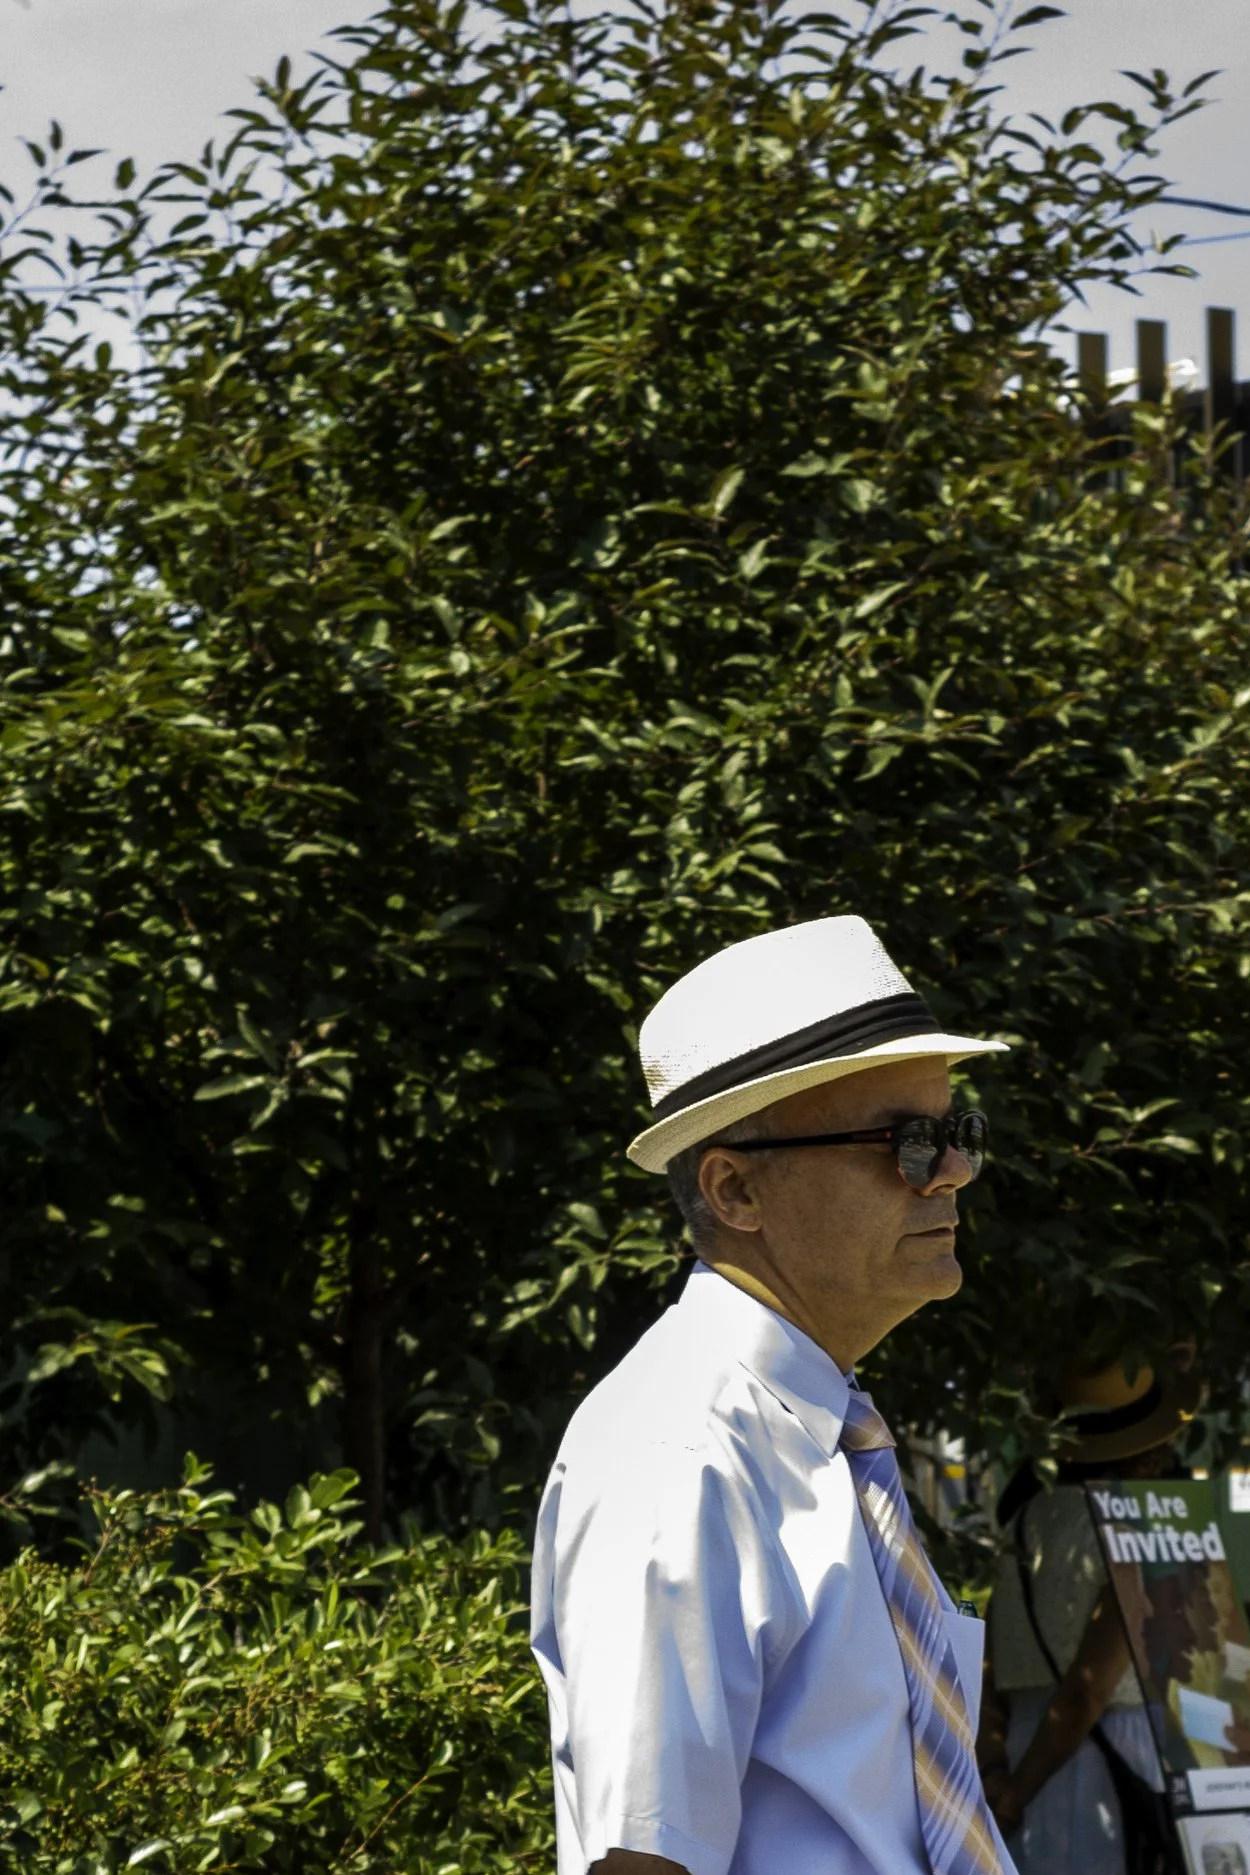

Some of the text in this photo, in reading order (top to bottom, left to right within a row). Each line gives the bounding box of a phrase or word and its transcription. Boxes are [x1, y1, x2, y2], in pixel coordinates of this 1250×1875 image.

[1092, 1490, 1189, 1520] You Are
[1103, 1522, 1226, 1563] Invited
